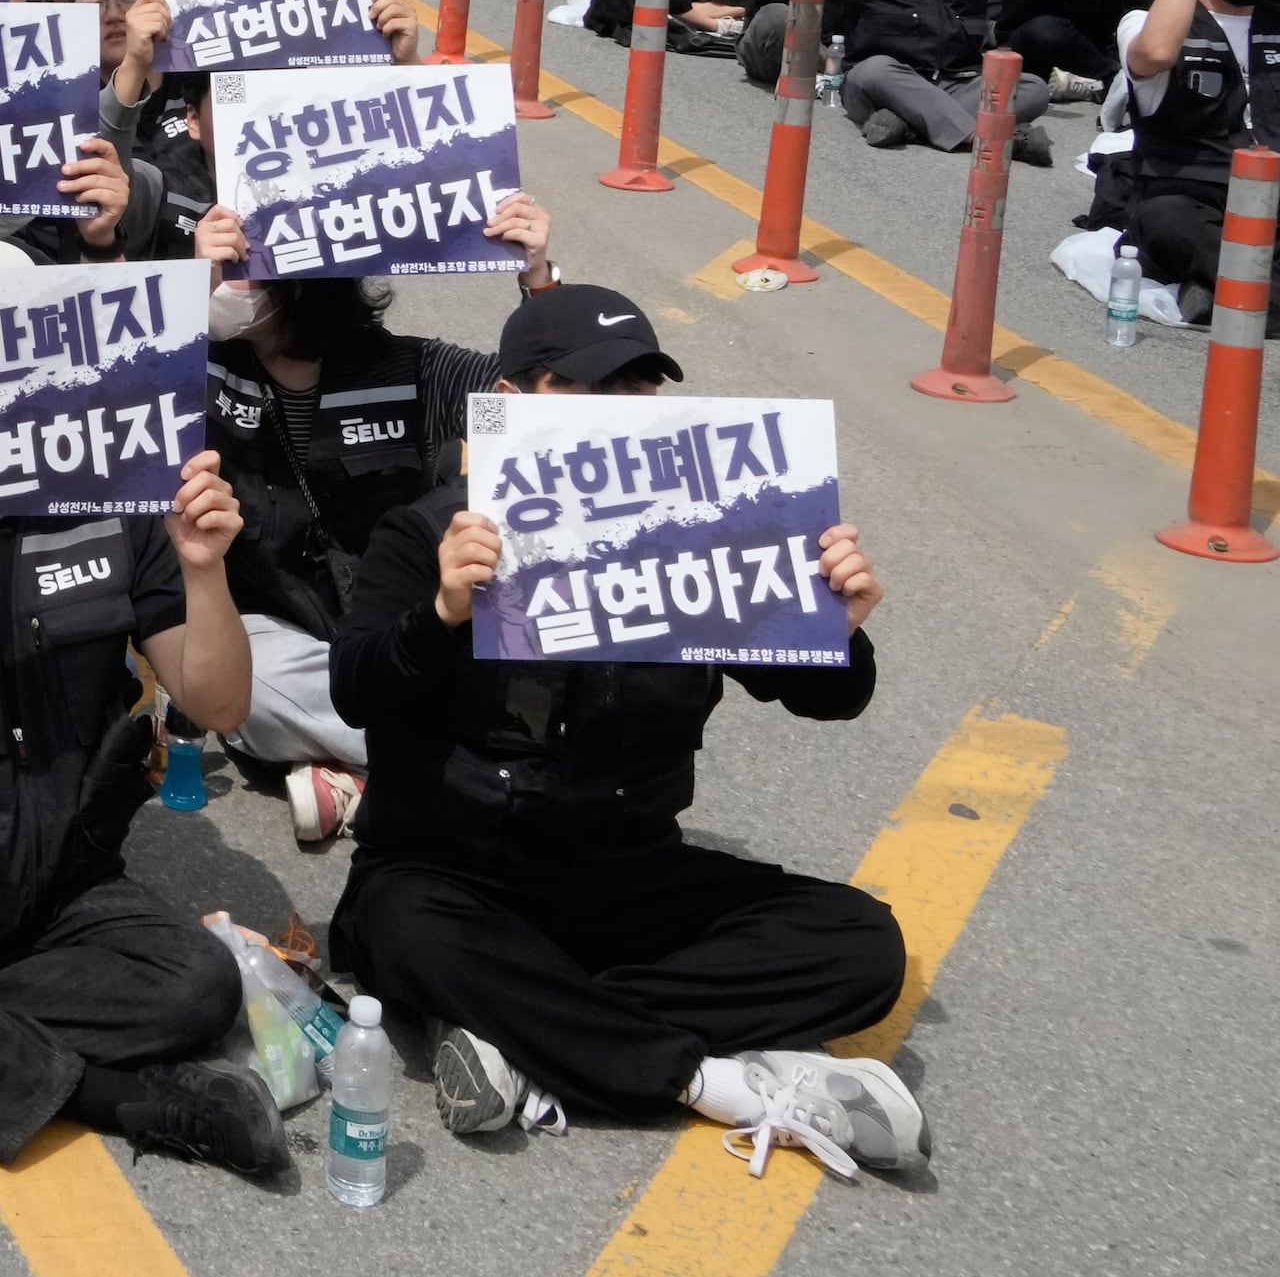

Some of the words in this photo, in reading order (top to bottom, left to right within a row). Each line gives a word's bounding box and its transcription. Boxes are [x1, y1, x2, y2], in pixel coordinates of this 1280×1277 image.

[288, 55, 346, 65] 삼성전자노동조합
[235, 75, 476, 180] 상한폐지
[264, 171, 522, 275] 실현하자
[390, 263, 465, 274] 삼성전자노동조합
[467, 260, 526, 273] 공동투쟁본부
[342, 420, 404, 445] SELU
[492, 412, 790, 532] 상한폐지
[48, 501, 135, 514] 삼성전자노동조합
[38, 557, 111, 595] SELU
[527, 535, 821, 654] 실현하자
[681, 647, 773, 662] 삼성전자노동조합
[775, 647, 846, 664] 공동투쟁본부
